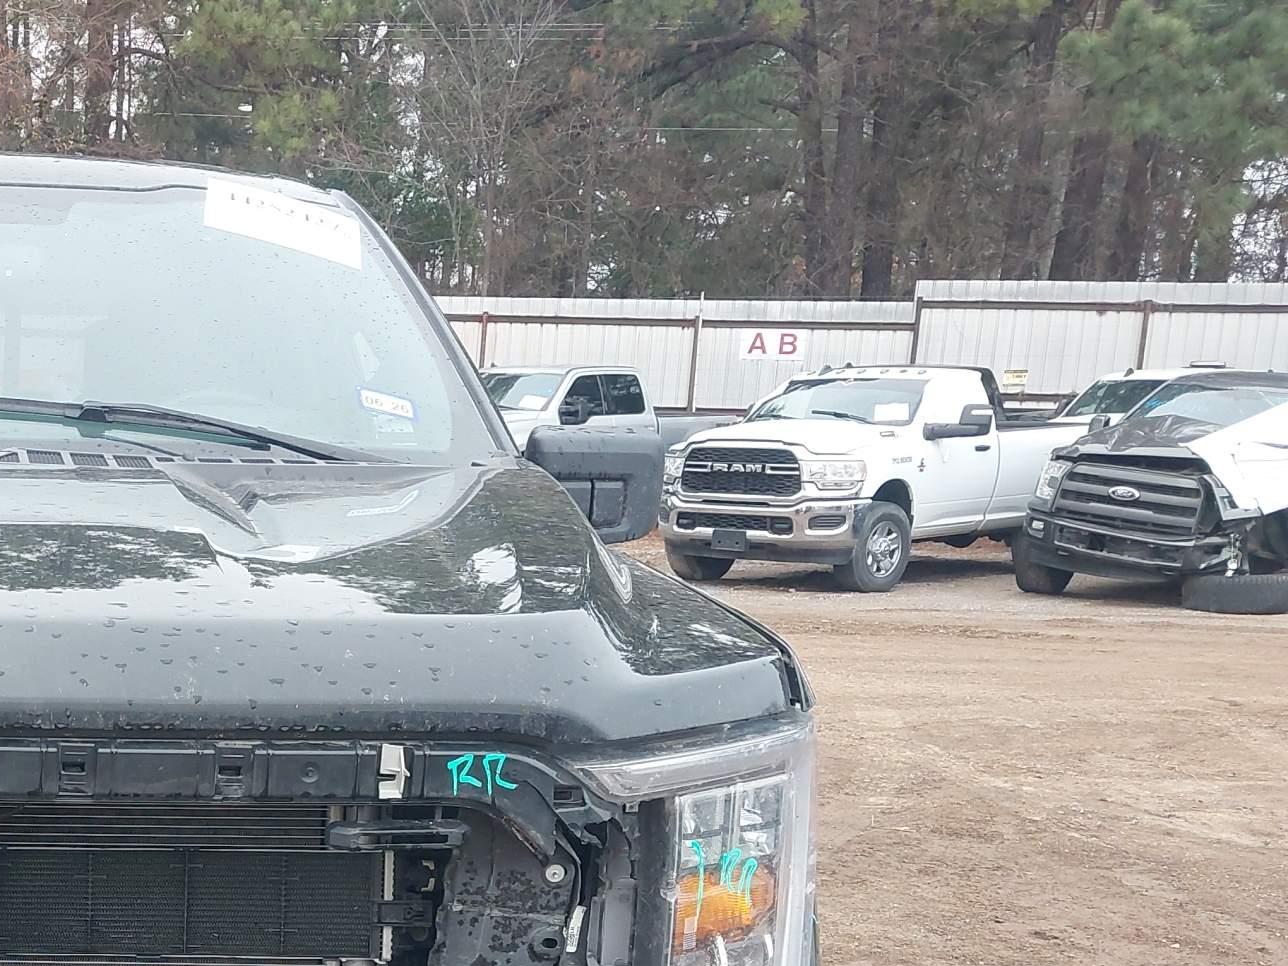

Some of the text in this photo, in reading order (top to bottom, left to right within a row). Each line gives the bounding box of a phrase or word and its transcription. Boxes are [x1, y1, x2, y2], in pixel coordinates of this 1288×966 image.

[747, 332, 798, 355] A B
[712, 462, 763, 473] RAM
